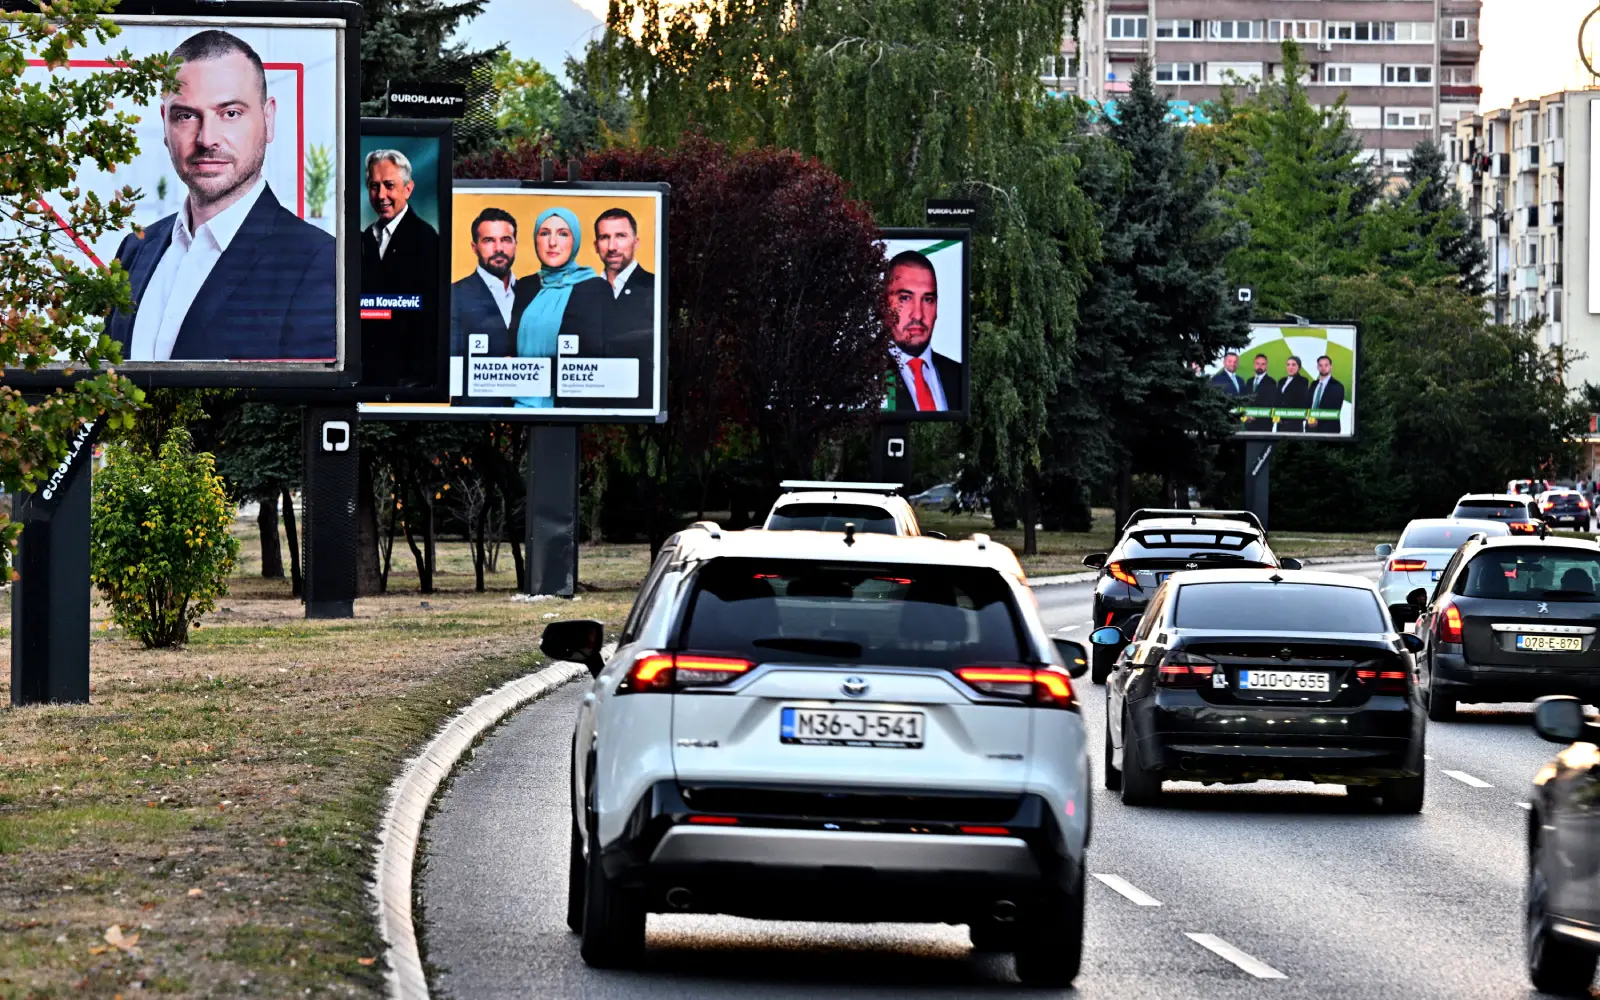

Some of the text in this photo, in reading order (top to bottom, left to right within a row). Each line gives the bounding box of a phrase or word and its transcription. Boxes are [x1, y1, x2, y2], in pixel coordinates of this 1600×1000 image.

[376, 295, 420, 308] Kovačević
[474, 339, 485, 349] 2.
[563, 340, 574, 349] 3.
[473, 363, 545, 371] NAIDA HOTA-
[562, 363, 598, 371] ADNAN
[473, 371, 539, 381] MUMINOVIĆ
[562, 372, 594, 381] DELIĆ
[1524, 637, 1580, 649] 078-E-879
[799, 712, 920, 739] M36-J-541
